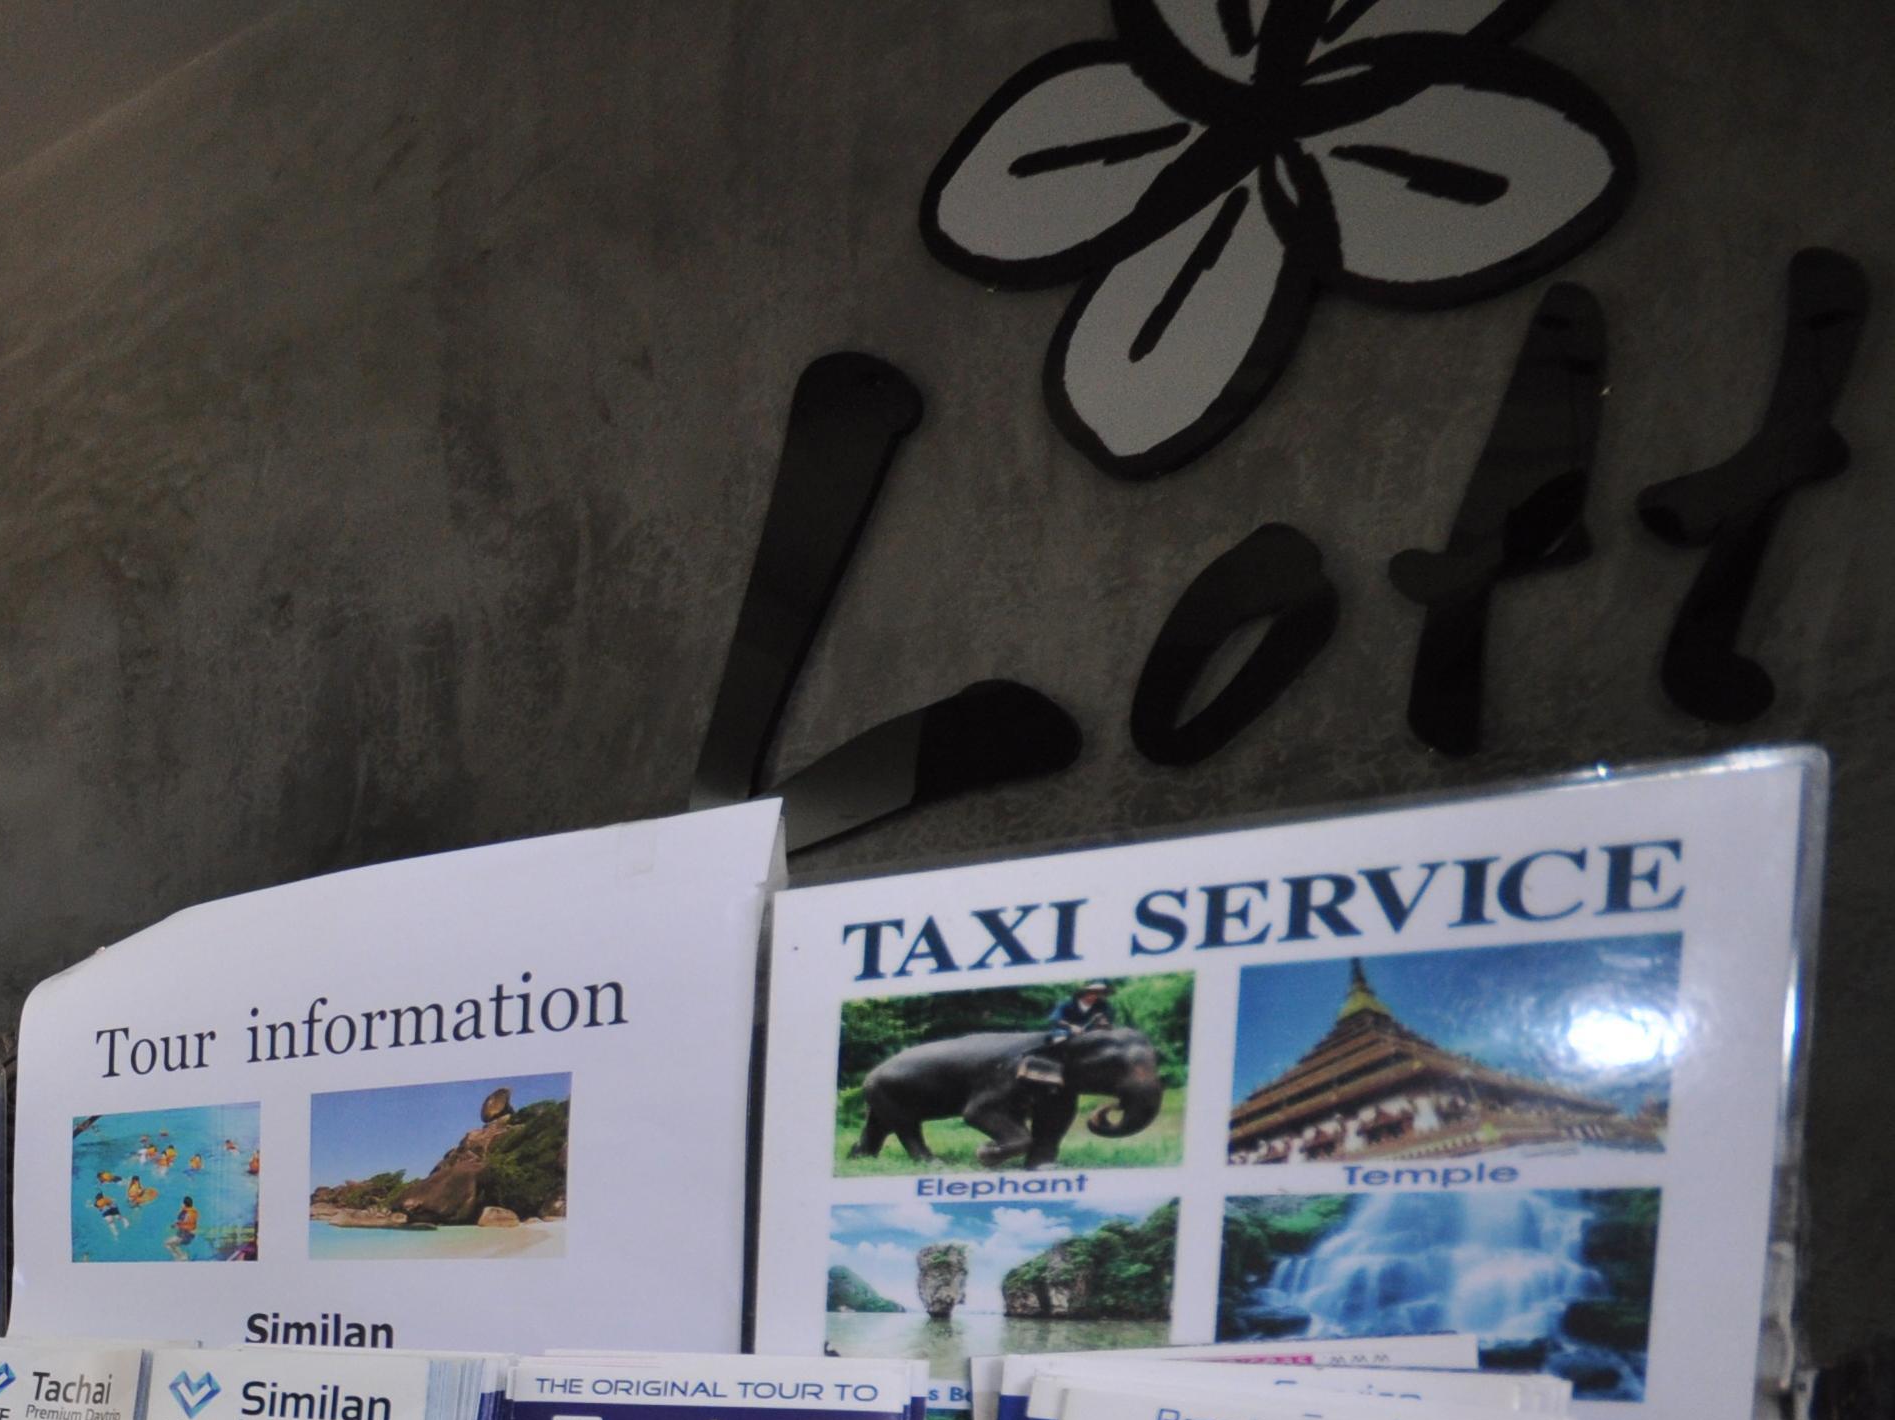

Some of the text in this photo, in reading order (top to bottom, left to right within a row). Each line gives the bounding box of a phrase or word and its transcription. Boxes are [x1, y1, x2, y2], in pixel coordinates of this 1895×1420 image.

[843, 838, 1685, 983] TAXI SERVICE
[96, 971, 629, 1078] Tour information
[915, 1170, 1089, 1200] Elephant
[1343, 1160, 1518, 1190] Temple
[246, 1311, 395, 1349] Similan
[32, 1372, 112, 1405] Tachai
[535, 1378, 879, 1402] THE ORIGINAL TOUR TO
